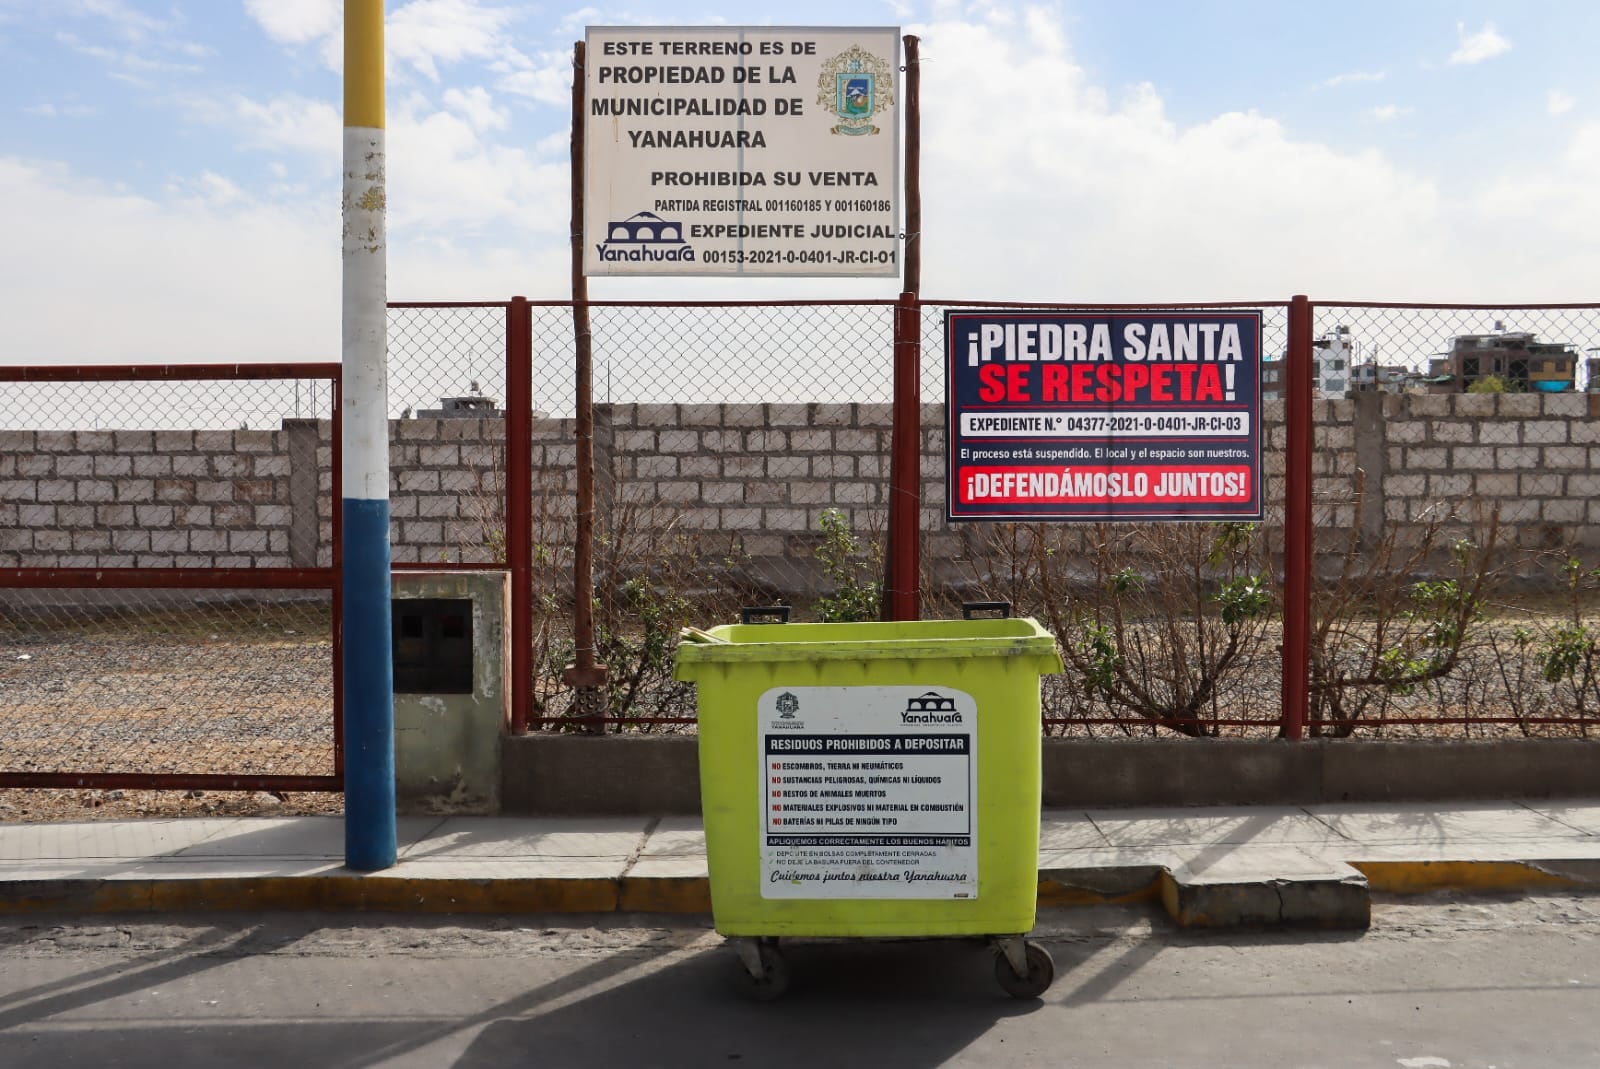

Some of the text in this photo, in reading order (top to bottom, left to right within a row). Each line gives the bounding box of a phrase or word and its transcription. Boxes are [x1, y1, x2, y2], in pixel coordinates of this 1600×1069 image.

[603, 42, 816, 55] ESTE TERRENO ES DE
[599, 67, 796, 83] PROPIEDAD DE LA
[592, 99, 803, 116] MUNICIPALIDAD DE
[629, 131, 766, 147] YANAHUARA
[651, 172, 878, 185] PROHIBIDA SU VENTA
[655, 200, 891, 212] PARTIDA REGISTRAL 001160185 Y 001160186
[691, 225, 895, 238] EXPEDIENTE JUDICIAL
[596, 244, 695, 262] Yanahuara
[968, 323, 1243, 366] ¡PIEDRA SANTA
[979, 363, 1235, 402] SE RESPETA!
[970, 418, 1043, 431] EXPEDIENTE
[1068, 417, 1241, 431] 04377-2021-0-0401-JR-CI-03
[960, 448, 1250, 460] El proceso está suspendido. El local y el espacio son nuestros.
[968, 468, 1245, 501] ¡DEFENDÁMOSLO JUNTOS!
[901, 712, 962, 723] Yanahuara
[770, 739, 964, 750] RESIDUOS PROHIBIDOS A DEPOSITAR
[782, 762, 825, 771] ESCOMBROS,
[828, 762, 850, 770] TIERRA
[862, 761, 904, 770] NEUMÁTICOS
[824, 777, 866, 785] PELIGROSAS,
[868, 775, 900, 784] QUÍMICAS
[902, 776, 910, 784] NI
[912, 775, 941, 784] LÍQUIDOS
[772, 790, 886, 798] NO RESTOS DE ANIMALES MUERTOS
[772, 804, 782, 812] NO
[783, 804, 824, 812] MATERIALES
[826, 804, 865, 812] EXPLOSIVOS
[876, 804, 908, 812] MATERIAL
[910, 804, 918, 812] EN
[773, 818, 782, 826] NO
[784, 816, 814, 825] BATERÍAS
[856, 816, 880, 825] NINGÚN
[822, 871, 856, 884] juntos
[858, 872, 900, 882] nuestra
[904, 870, 968, 884] Yanahuara
